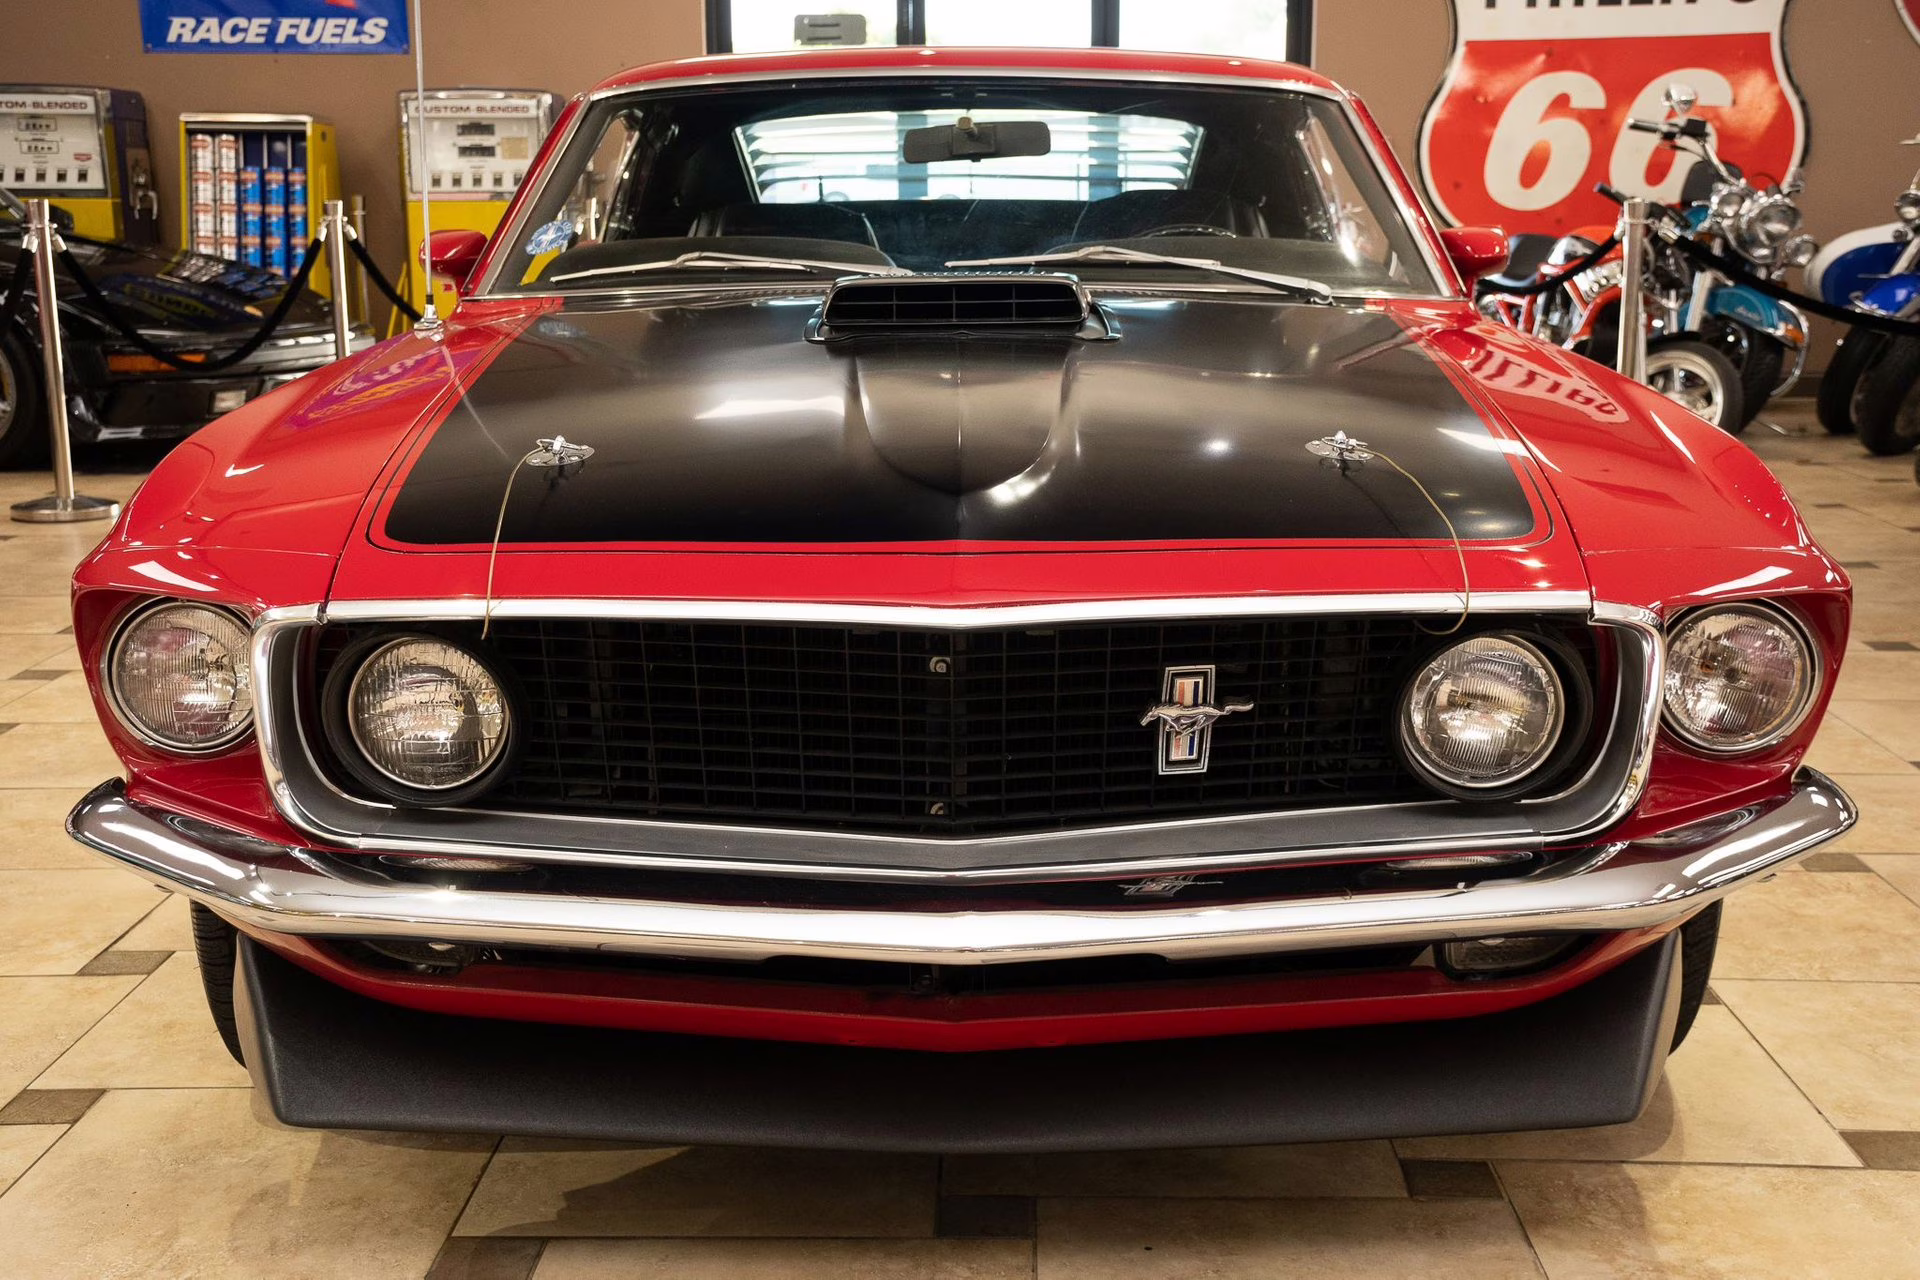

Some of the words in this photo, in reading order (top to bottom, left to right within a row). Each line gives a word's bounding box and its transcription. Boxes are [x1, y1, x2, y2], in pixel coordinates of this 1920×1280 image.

[166, 16, 272, 44] RACE
[275, 16, 389, 44] FUELS
[1484, 67, 1734, 212] 66
